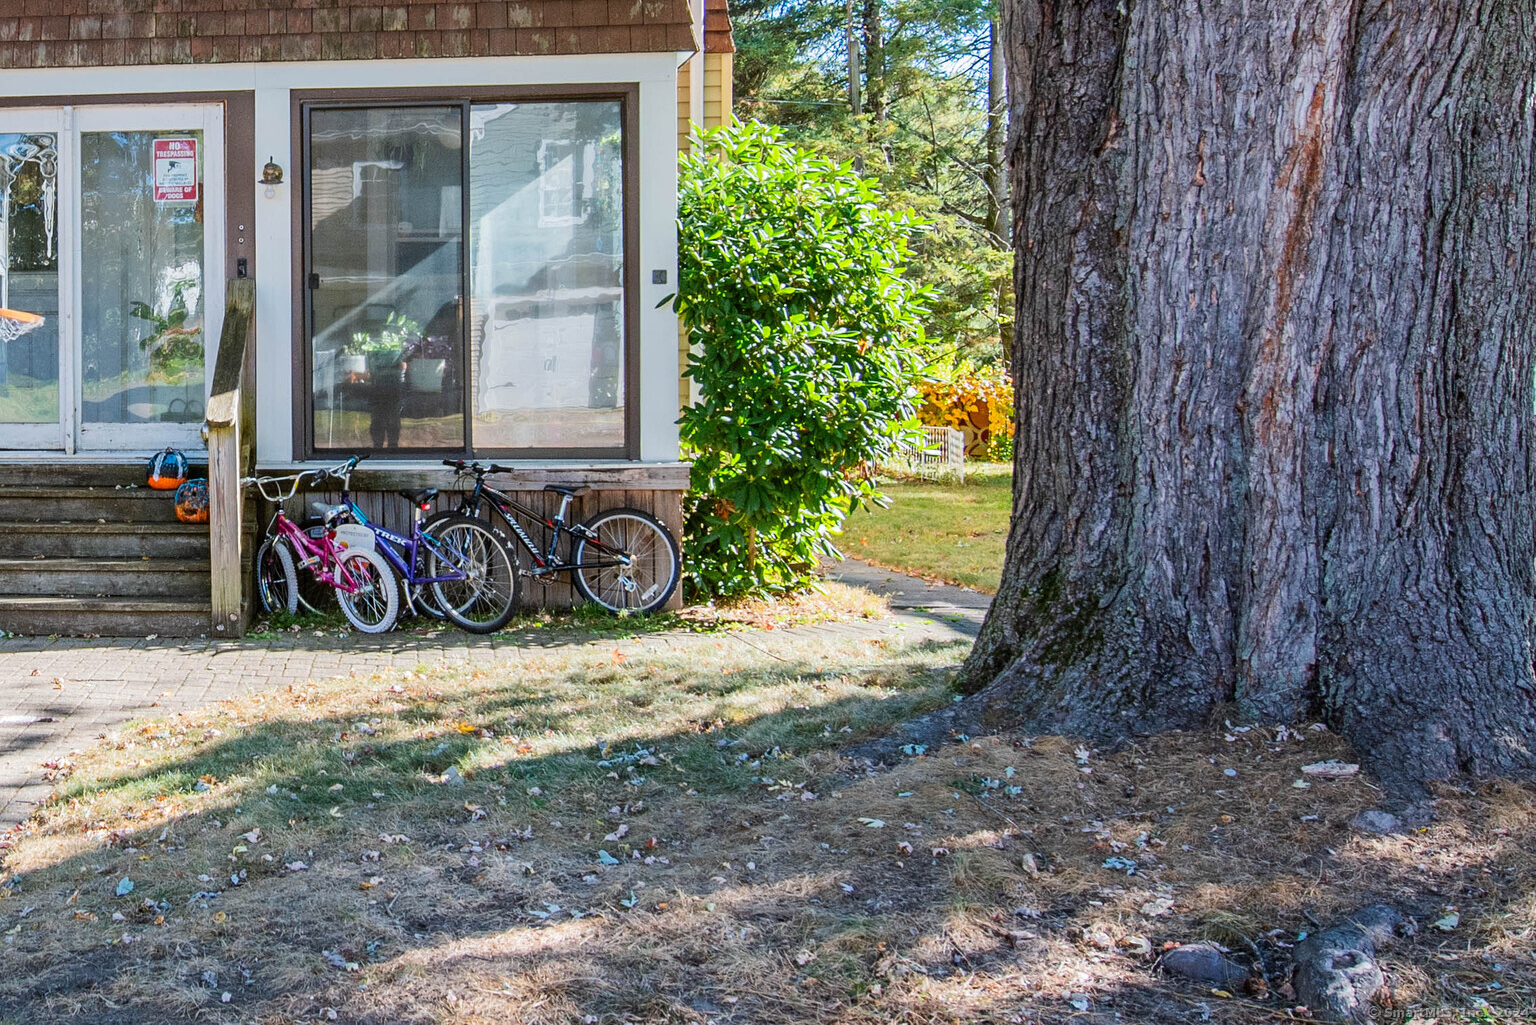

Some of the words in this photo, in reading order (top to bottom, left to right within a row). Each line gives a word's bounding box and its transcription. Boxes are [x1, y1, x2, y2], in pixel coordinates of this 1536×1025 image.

[169, 141, 181, 150] NO
[156, 150, 194, 158] TRESPASSING
[374, 527, 407, 546] TREK
